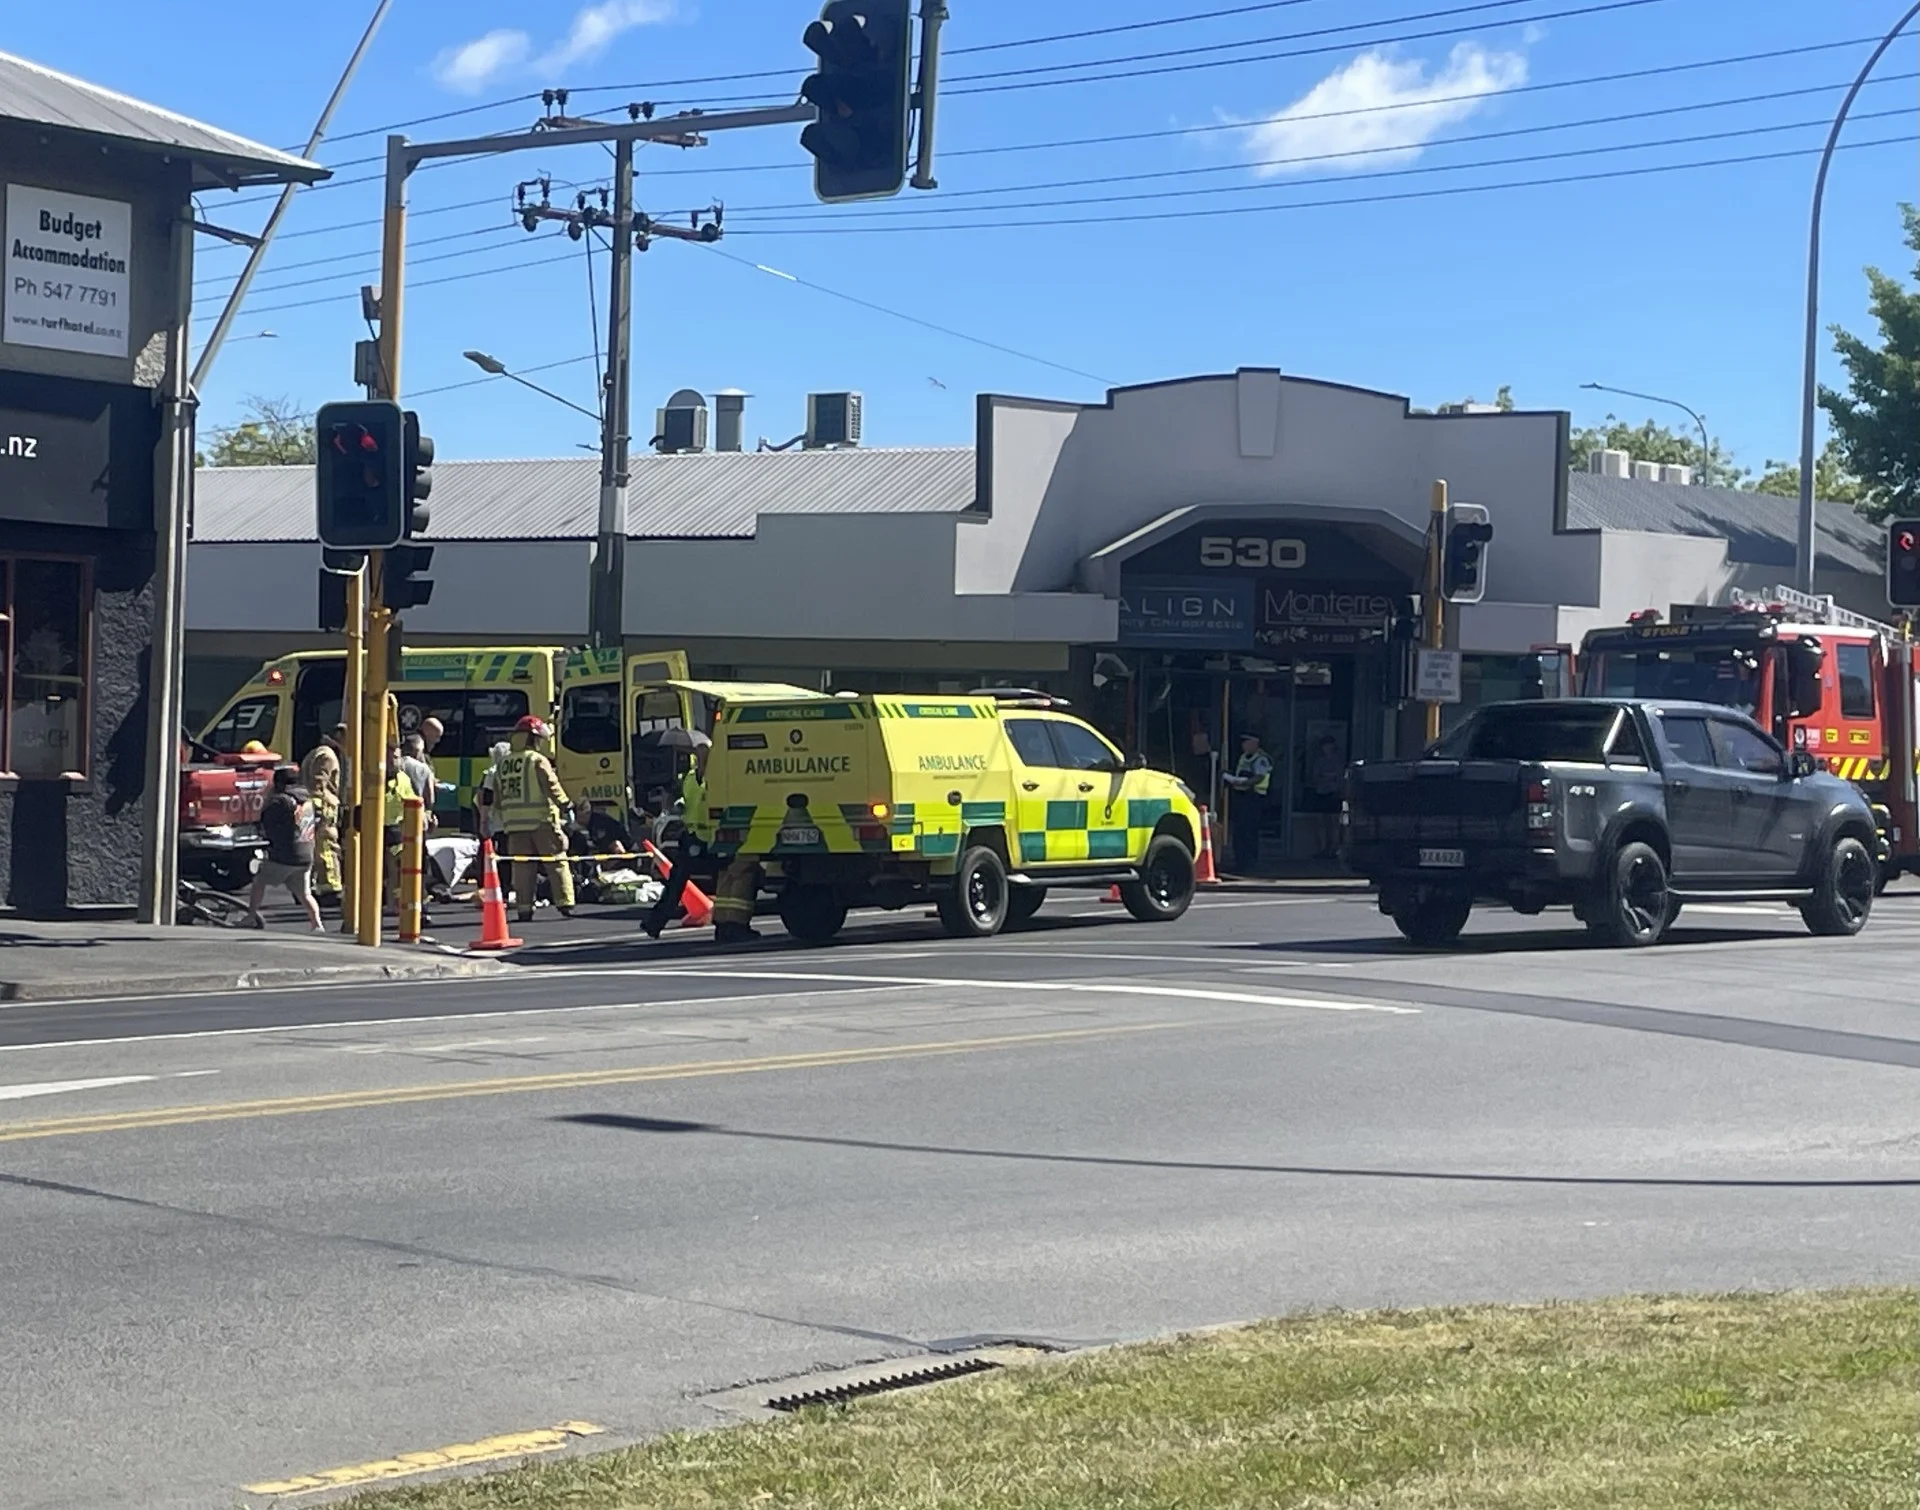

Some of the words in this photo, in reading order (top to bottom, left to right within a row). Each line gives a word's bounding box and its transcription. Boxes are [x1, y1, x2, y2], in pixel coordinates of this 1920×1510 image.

[39, 209, 102, 241] Budget
[12, 239, 126, 274] Accommodation
[14, 277, 37, 296] Ph
[43, 280, 73, 301] 547
[79, 285, 117, 307] 7791
[12, 315, 122, 340] www.turfhotel.co.nz
[0, 436, 37, 458] .nz
[1200, 536, 1307, 569] 530
[1118, 597, 1236, 617] ALIGN
[1642, 626, 1690, 638] STOKE
[501, 758, 523, 775] OIC
[745, 756, 852, 775] AMBULANCE
[918, 754, 988, 771] AMBULANCE
[582, 784, 623, 798] AMBU
